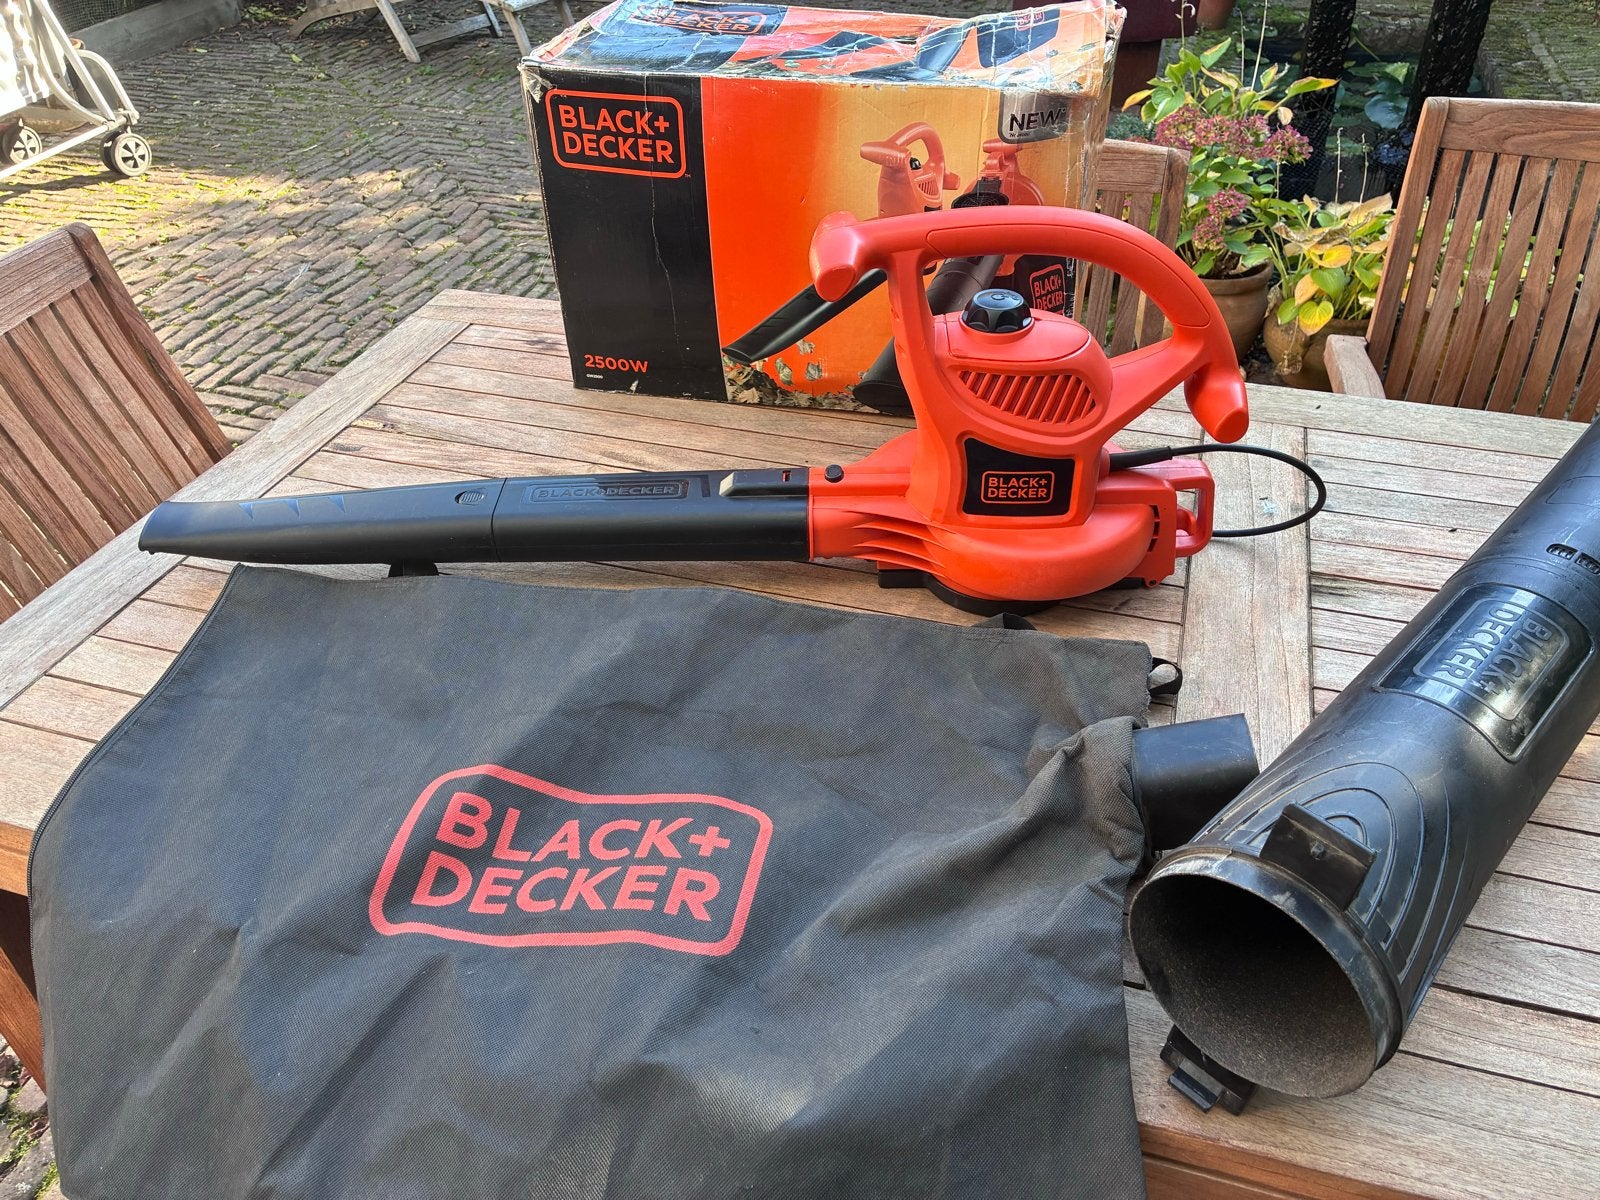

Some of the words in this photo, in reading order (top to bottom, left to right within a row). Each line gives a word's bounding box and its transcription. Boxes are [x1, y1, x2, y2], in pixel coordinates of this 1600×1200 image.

[558, 104, 670, 136] BLACK+
[562, 131, 675, 164] DECKER
[1033, 274, 1062, 297] BLACK+
[1036, 291, 1064, 310] DECKER
[584, 354, 649, 373] 2500W
[987, 488, 1048, 498] DECKER
[988, 477, 1048, 488] BLACK+
[1434, 605, 1523, 682] DECKER
[1478, 617, 1553, 695] BLACK+
[435, 792, 731, 863] BLACK+
[411, 850, 721, 922] DECKER
